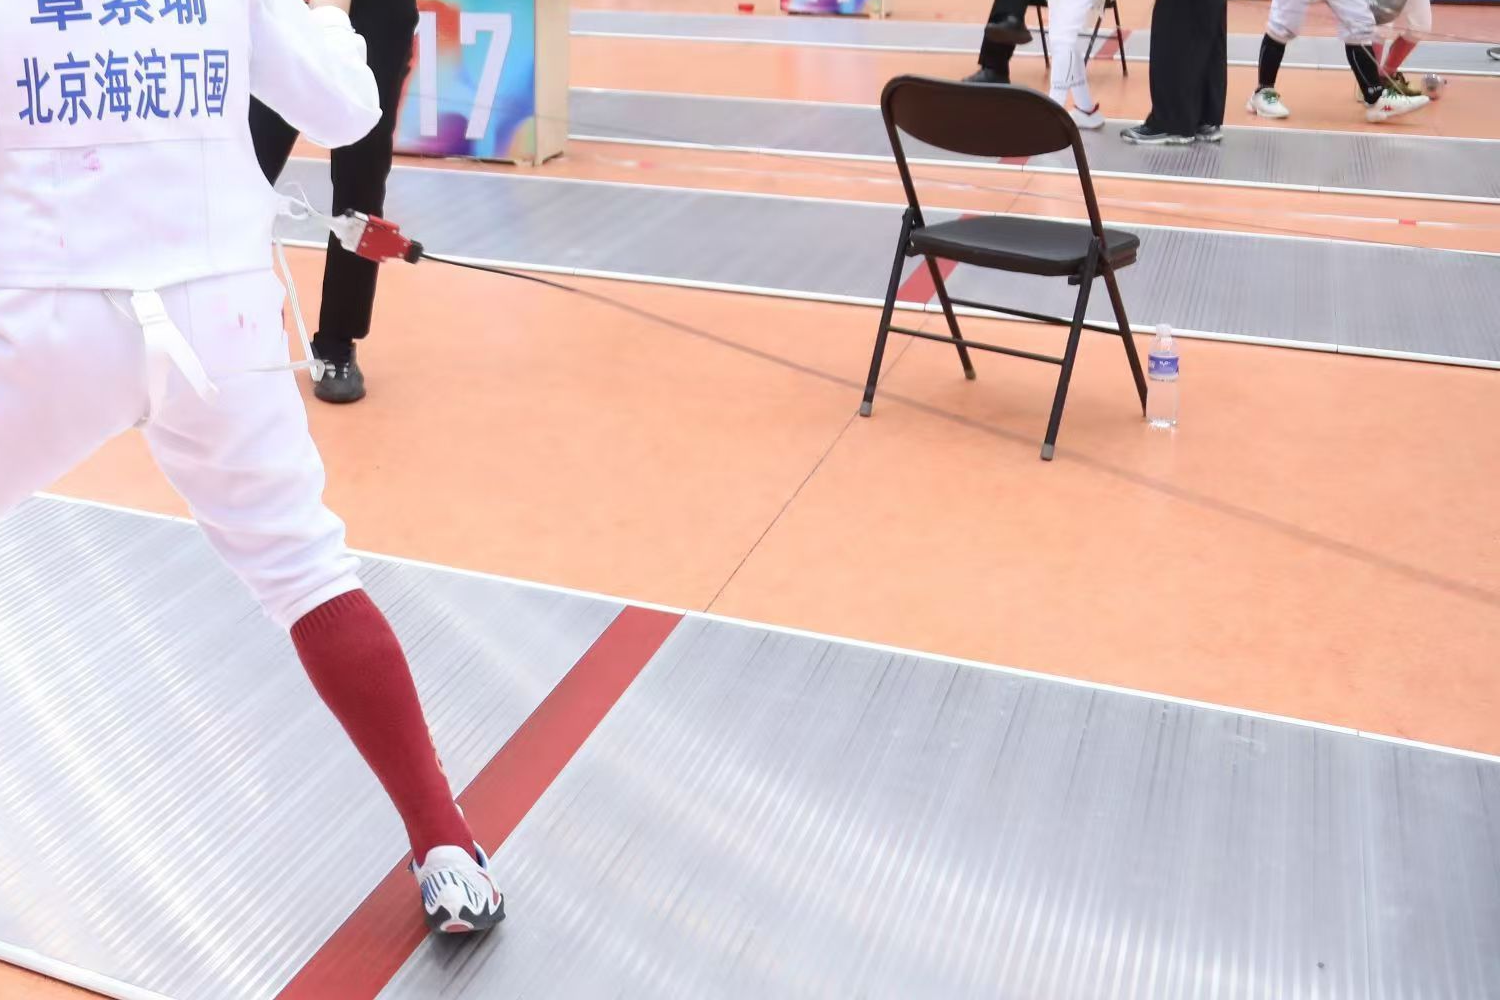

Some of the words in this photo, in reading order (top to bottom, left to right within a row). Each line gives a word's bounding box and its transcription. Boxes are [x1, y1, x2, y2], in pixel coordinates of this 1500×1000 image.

[17, 48, 230, 126] 北京海淀万国
[413, 10, 513, 140] 17
